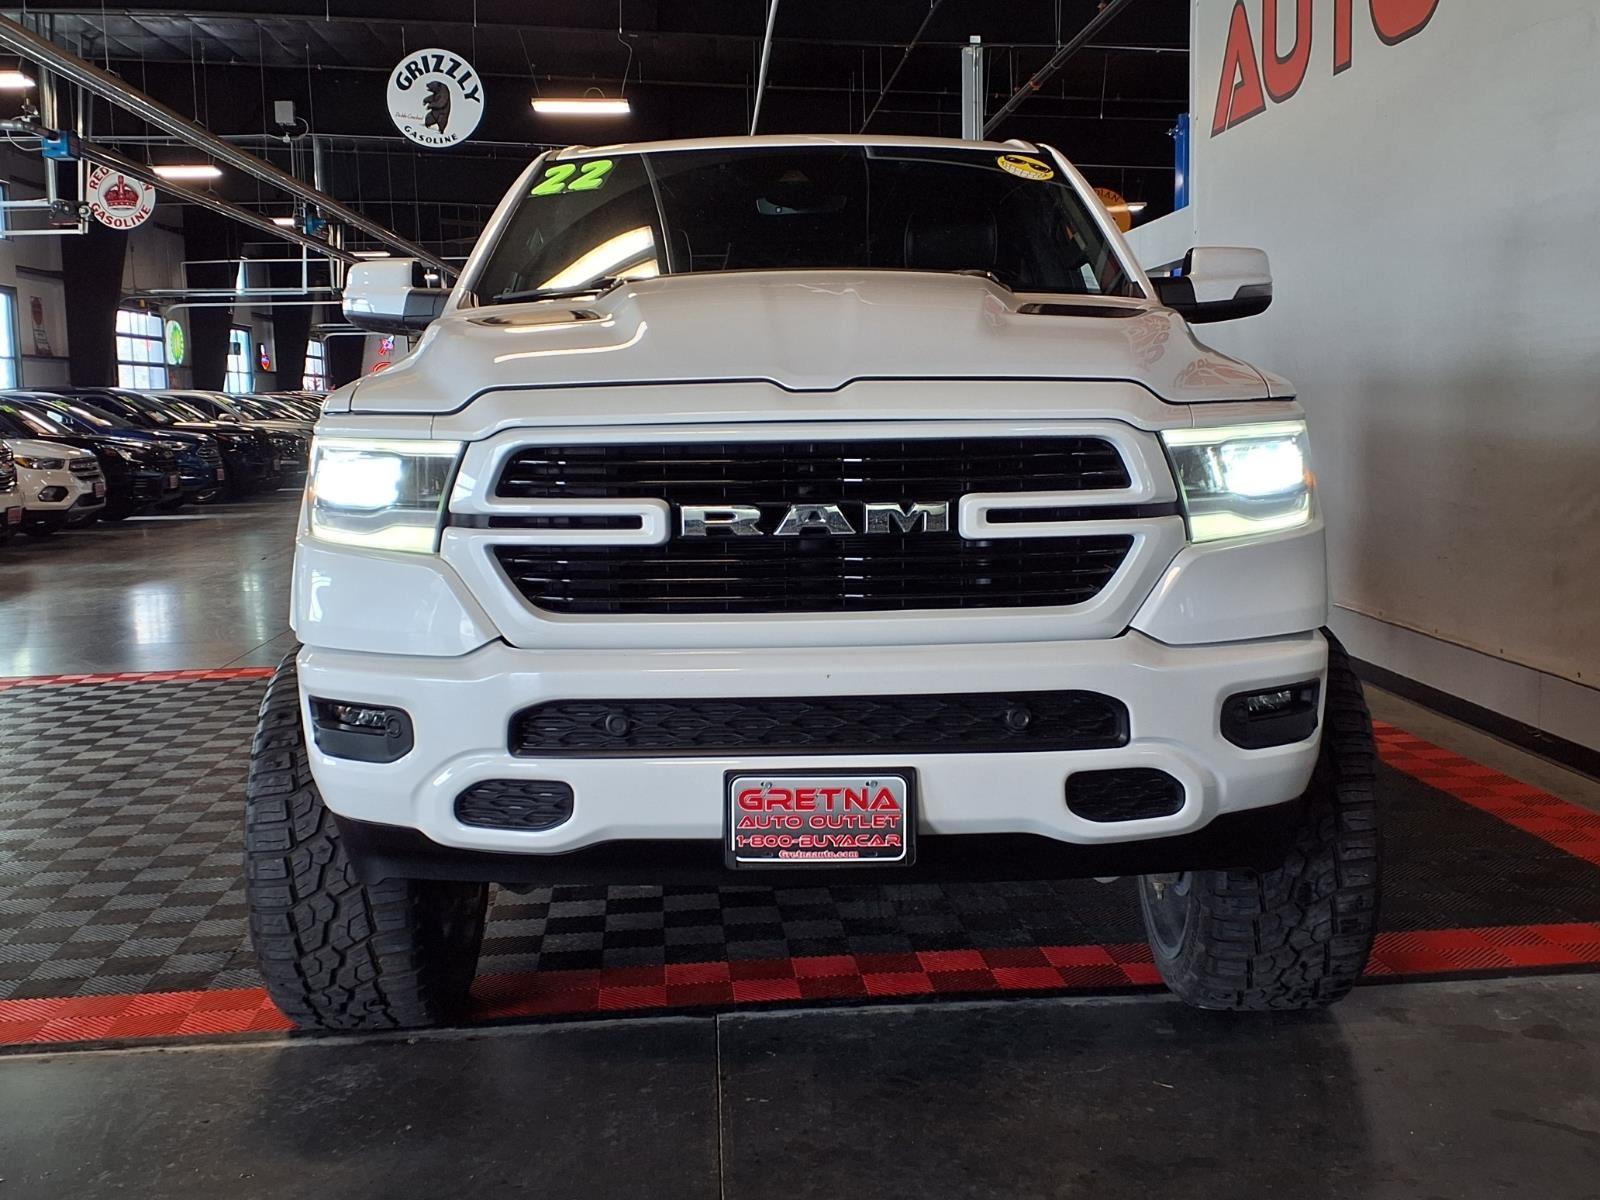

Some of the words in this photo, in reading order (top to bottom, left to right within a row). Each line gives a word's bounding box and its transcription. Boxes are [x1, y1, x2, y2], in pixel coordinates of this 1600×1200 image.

[396, 54, 481, 104] GRIZZLY
[404, 125, 458, 144] GASOLINE
[89, 166, 110, 190] RED
[531, 160, 613, 195] 22
[91, 203, 151, 228] GASOLINE
[680, 501, 950, 536] RAM
[737, 787, 901, 812] GRETNA
[737, 815, 804, 829] AUTO
[809, 814, 902, 829] OUTLET
[736, 834, 902, 848] 1-800-BUYACAR
